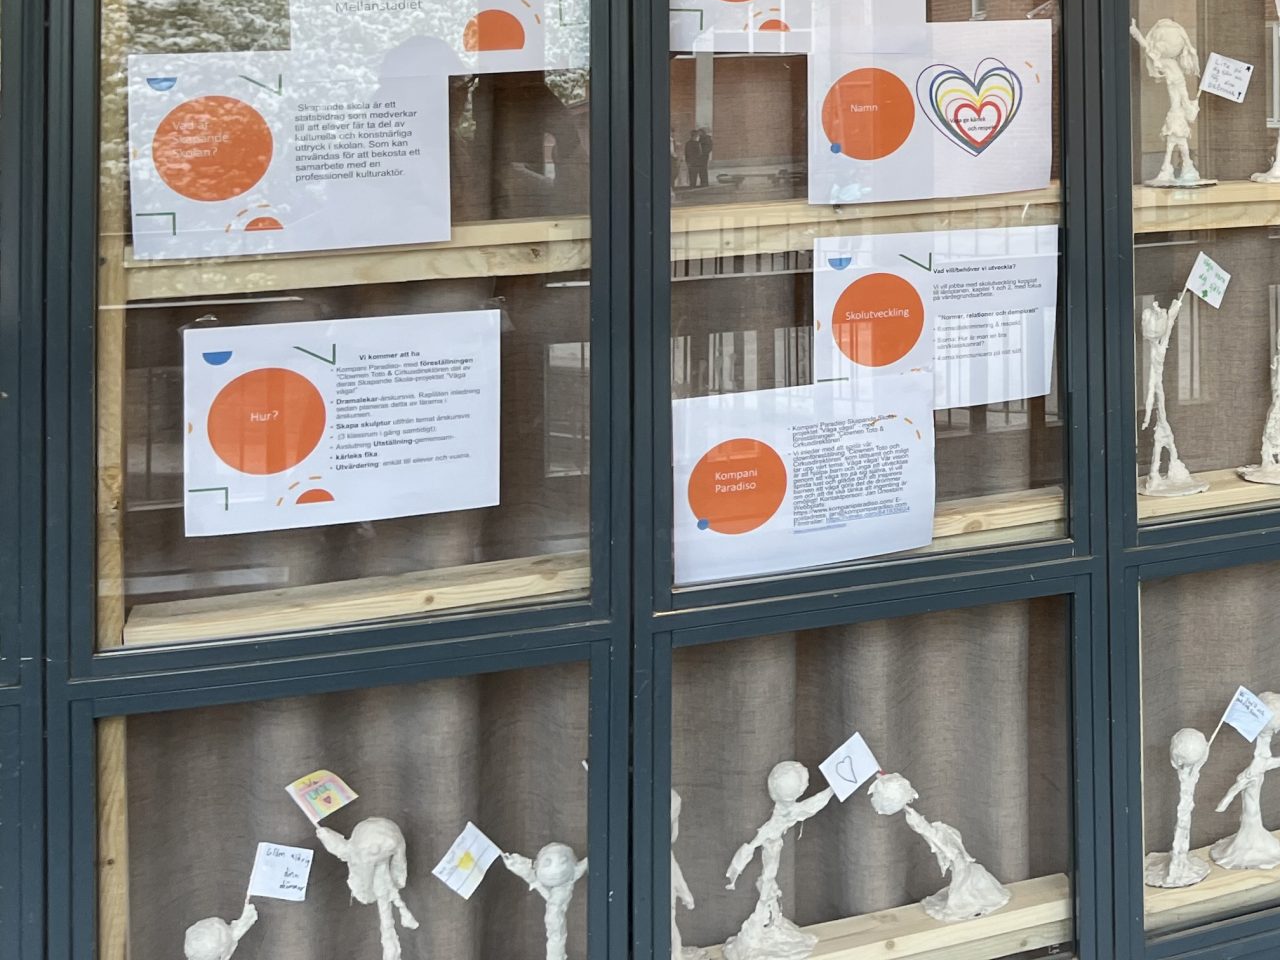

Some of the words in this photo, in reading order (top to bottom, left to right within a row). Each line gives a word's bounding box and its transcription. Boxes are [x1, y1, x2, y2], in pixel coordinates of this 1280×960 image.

[335, 0, 423, 12] Mellanstadiet
[850, 104, 878, 112] Namn
[295, 112, 345, 123] statsbidrag
[369, 110, 417, 118] medverkar
[322, 122, 350, 130] elever
[172, 134, 230, 146] Skapande
[295, 132, 336, 141] kulturella
[358, 129, 412, 140] konstnärliga
[173, 147, 218, 158] Skolan?
[295, 143, 325, 153] uttryck
[296, 152, 340, 161] användas
[371, 149, 406, 158] bekosta
[296, 162, 344, 171] samarbete
[296, 171, 353, 182] professionell
[846, 309, 909, 320] Skolutveckling
[420, 358, 473, 368] föreställningen
[250, 409, 279, 423] Hur?
[336, 422, 358, 431] Skapa
[361, 420, 391, 429] skulptur
[715, 469, 757, 482] Kompani
[715, 482, 756, 493] Paradiso
